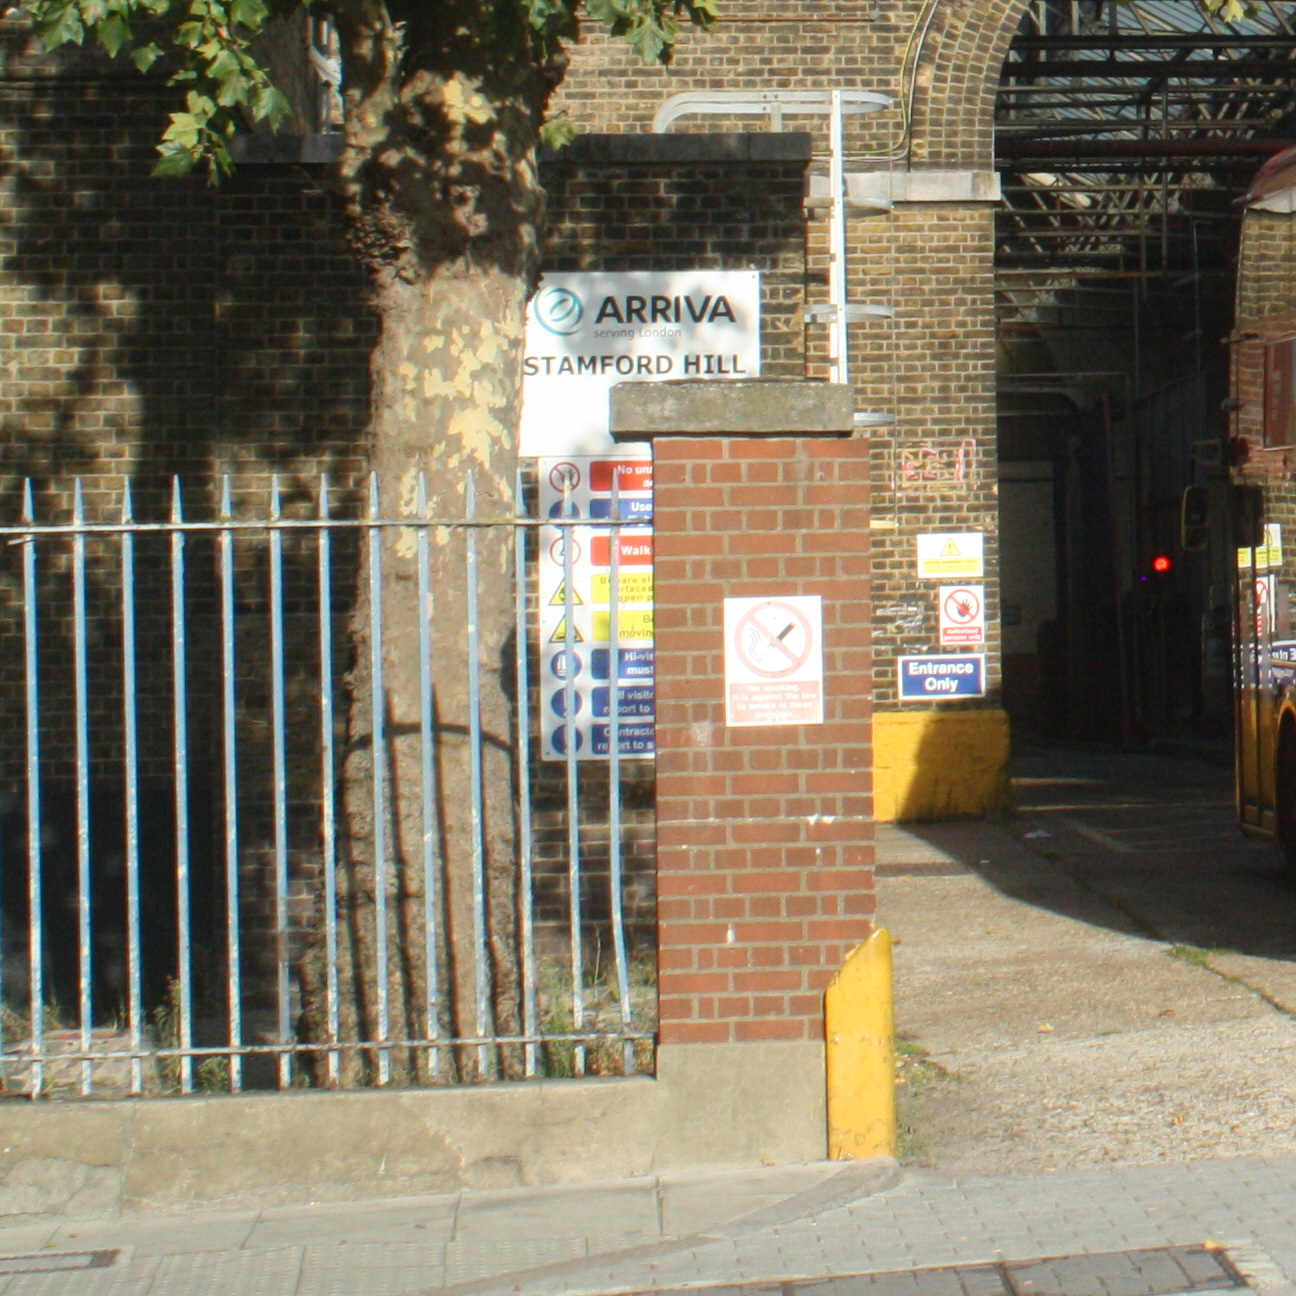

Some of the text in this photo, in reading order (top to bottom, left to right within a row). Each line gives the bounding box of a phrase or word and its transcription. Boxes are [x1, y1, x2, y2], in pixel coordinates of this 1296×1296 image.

[595, 295, 736, 323] ARRIVA
[594, 326, 682, 340] serving London
[523, 354, 746, 376] STAMFORD HILL
[618, 465, 633, 474] No
[631, 502, 652, 512] Use
[621, 546, 651, 555] Walk
[908, 662, 974, 675] Entrance
[925, 677, 959, 692] Only
[785, 692, 799, 700] the
[802, 692, 817, 700] law
[639, 704, 650, 713] to
[633, 740, 644, 749] to
